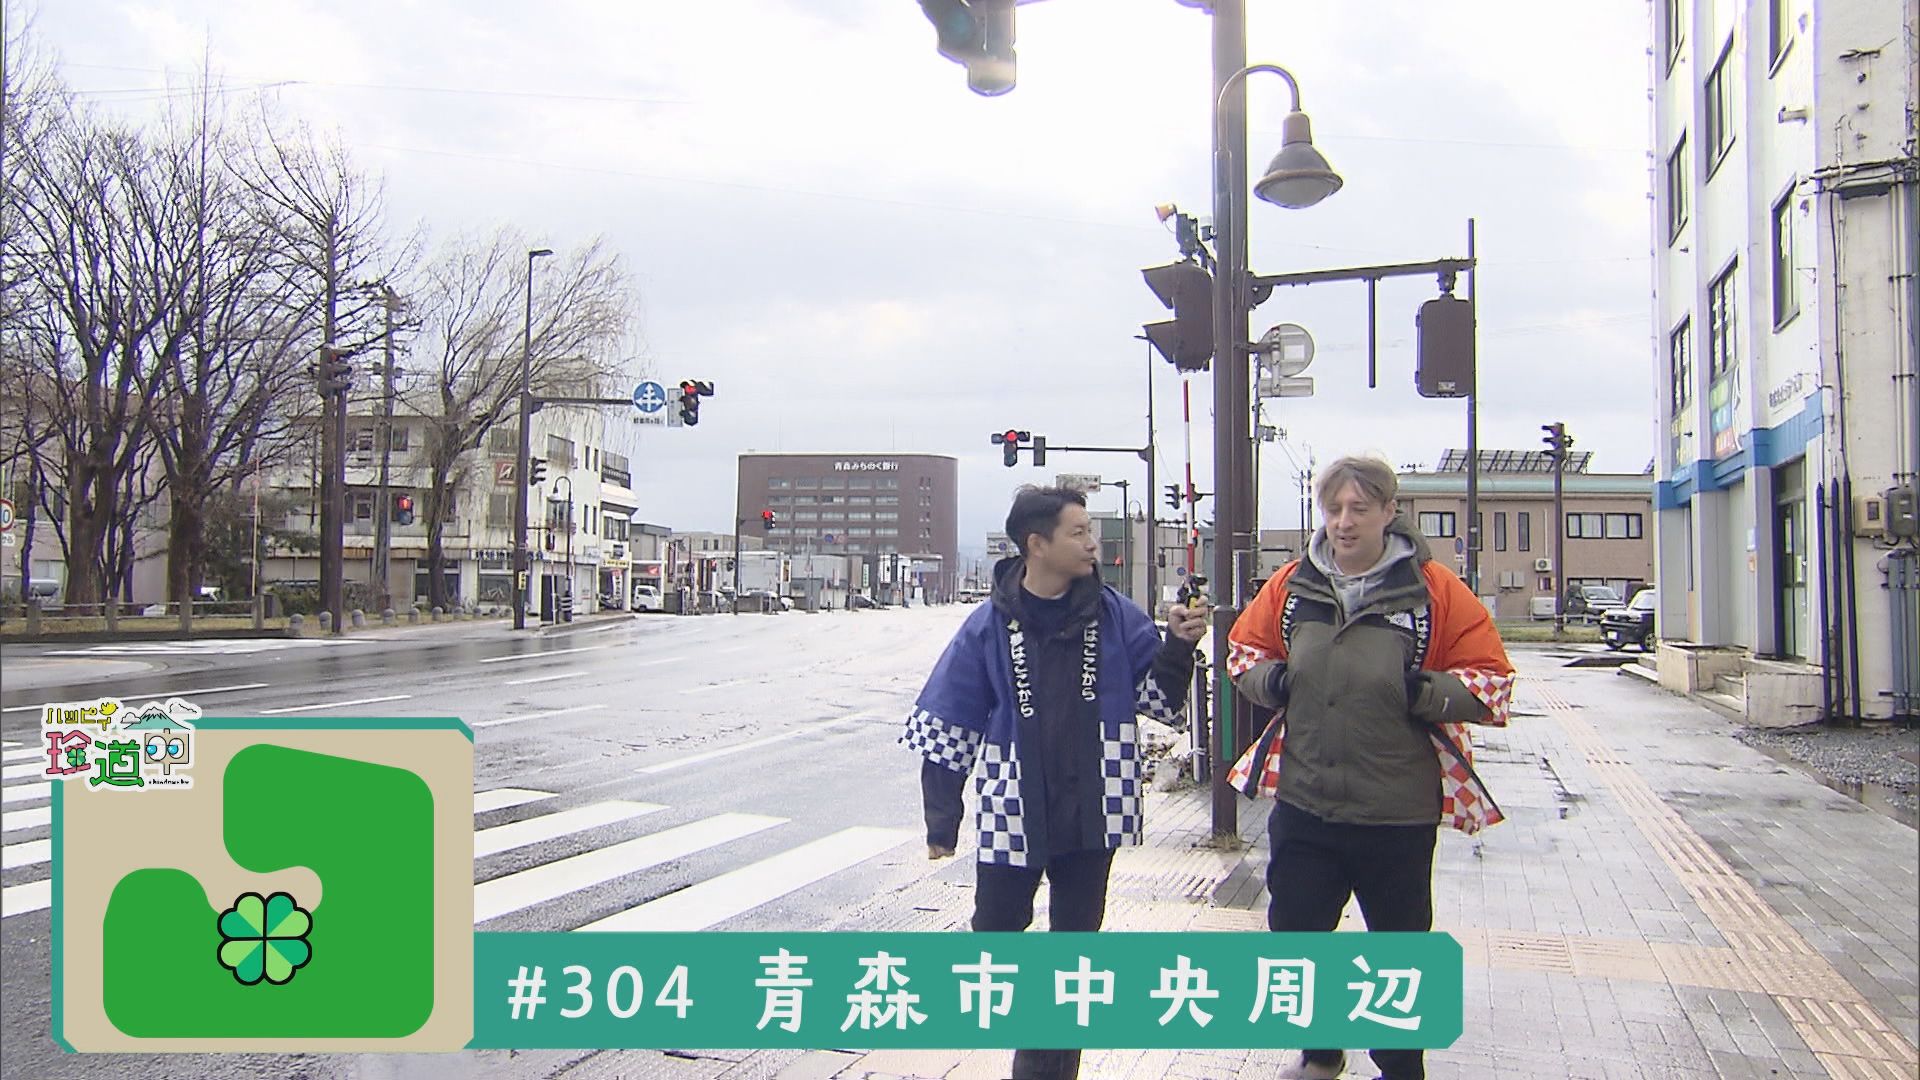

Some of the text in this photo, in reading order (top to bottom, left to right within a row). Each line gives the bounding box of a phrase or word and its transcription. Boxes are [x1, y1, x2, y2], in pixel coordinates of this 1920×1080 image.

[834, 461, 899, 471] 青森みちのく銀行
